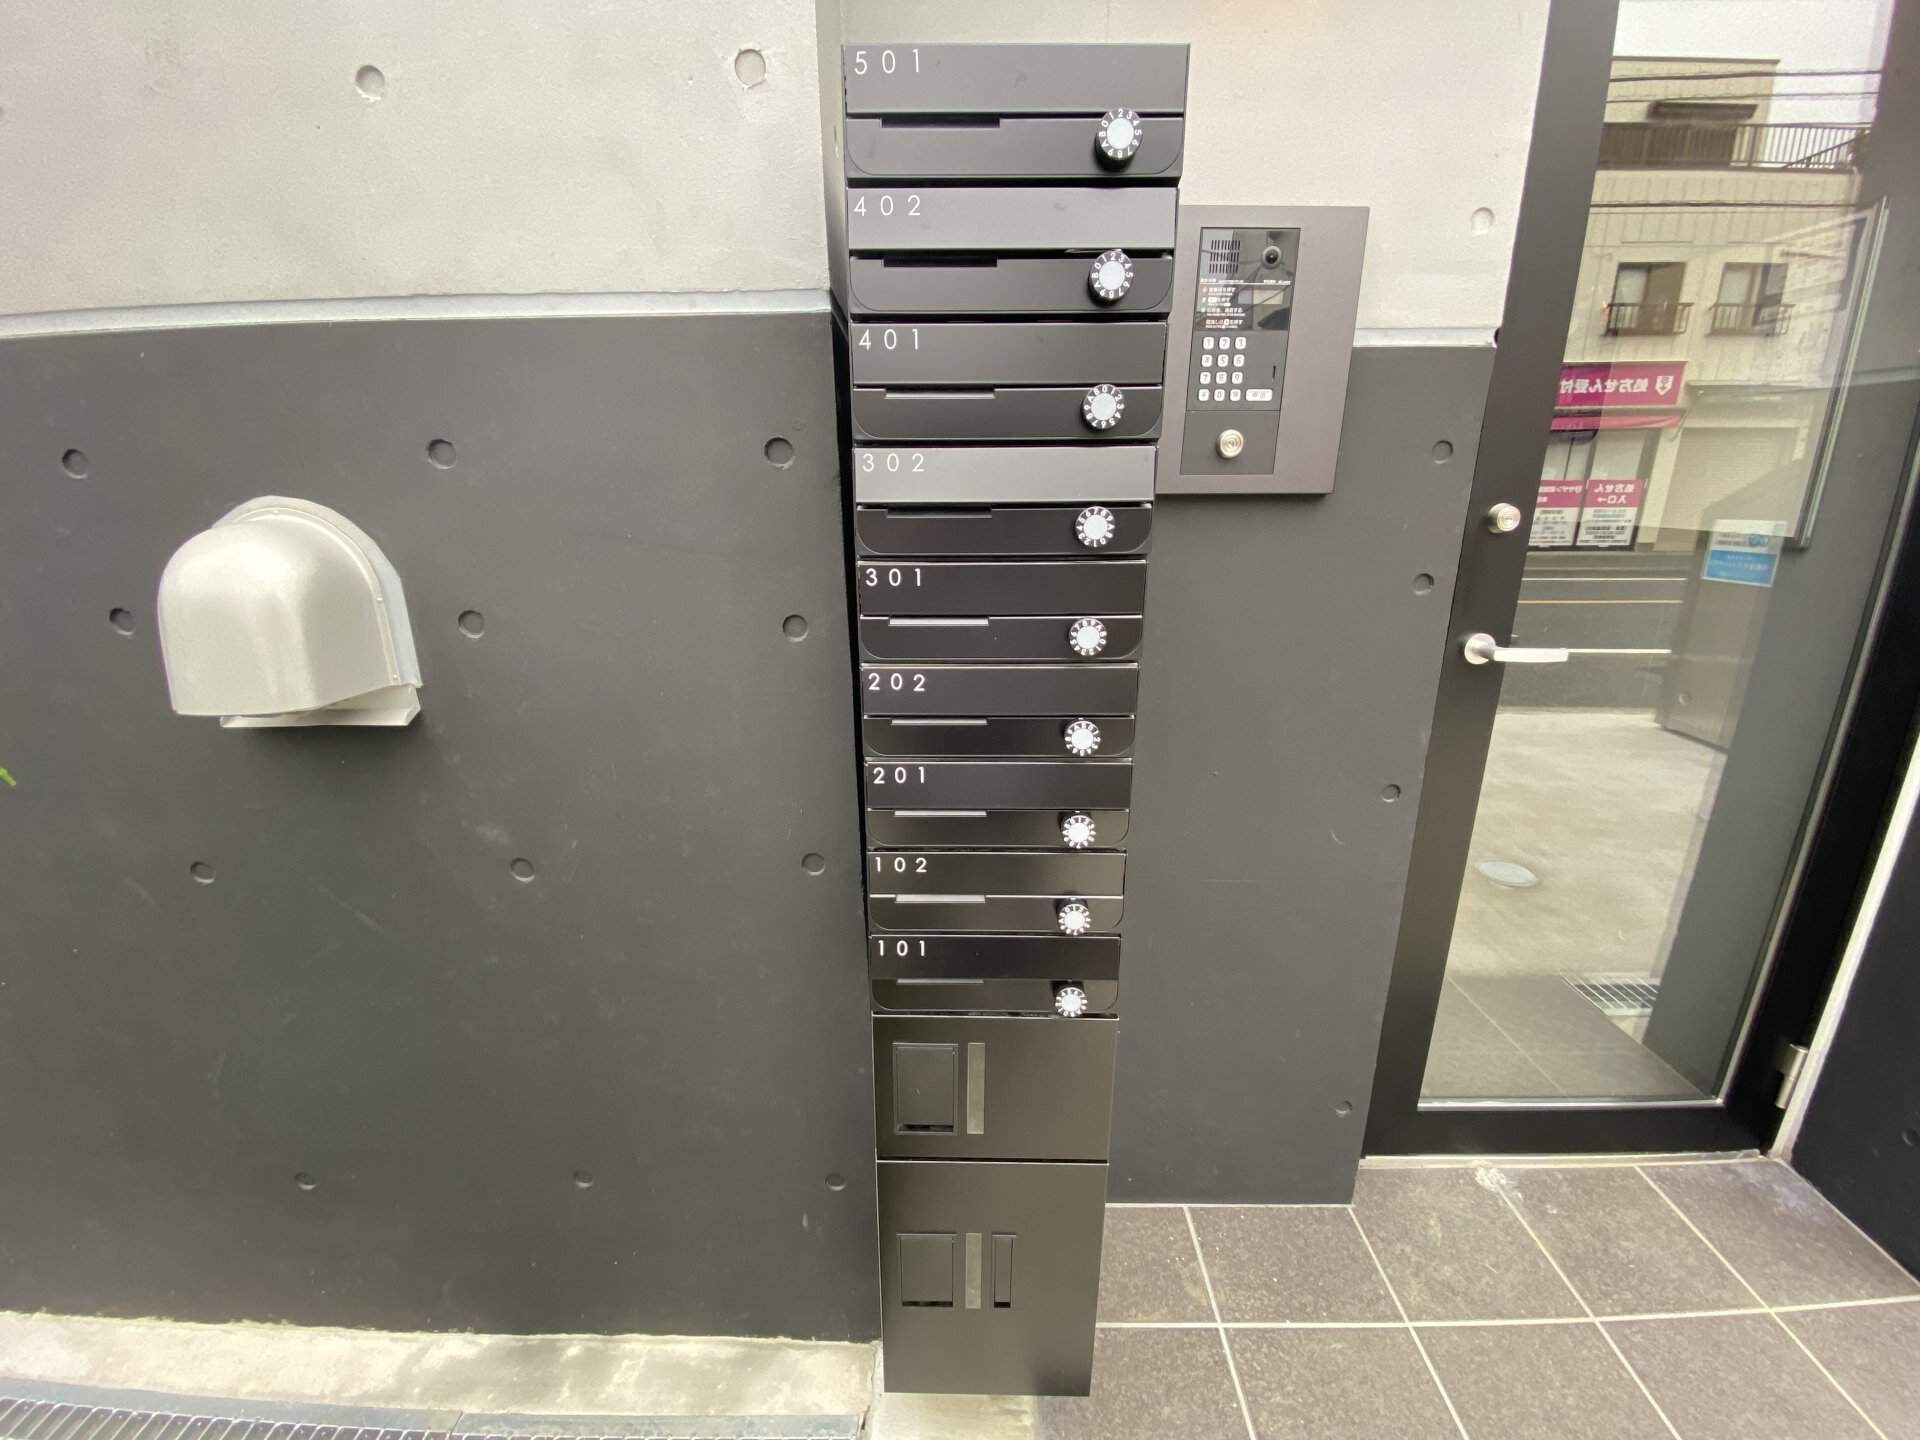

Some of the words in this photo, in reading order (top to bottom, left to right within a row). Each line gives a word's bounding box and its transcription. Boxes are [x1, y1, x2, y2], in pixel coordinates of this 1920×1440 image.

[854, 48, 919, 75] 501
[853, 194, 921, 217] 402
[858, 328, 919, 351] 401
[862, 452, 925, 473] 302
[865, 567, 921, 587] 301
[868, 672, 926, 692] 202
[873, 766, 925, 785] 201
[875, 856, 927, 873] 102
[878, 939, 925, 957] 101
